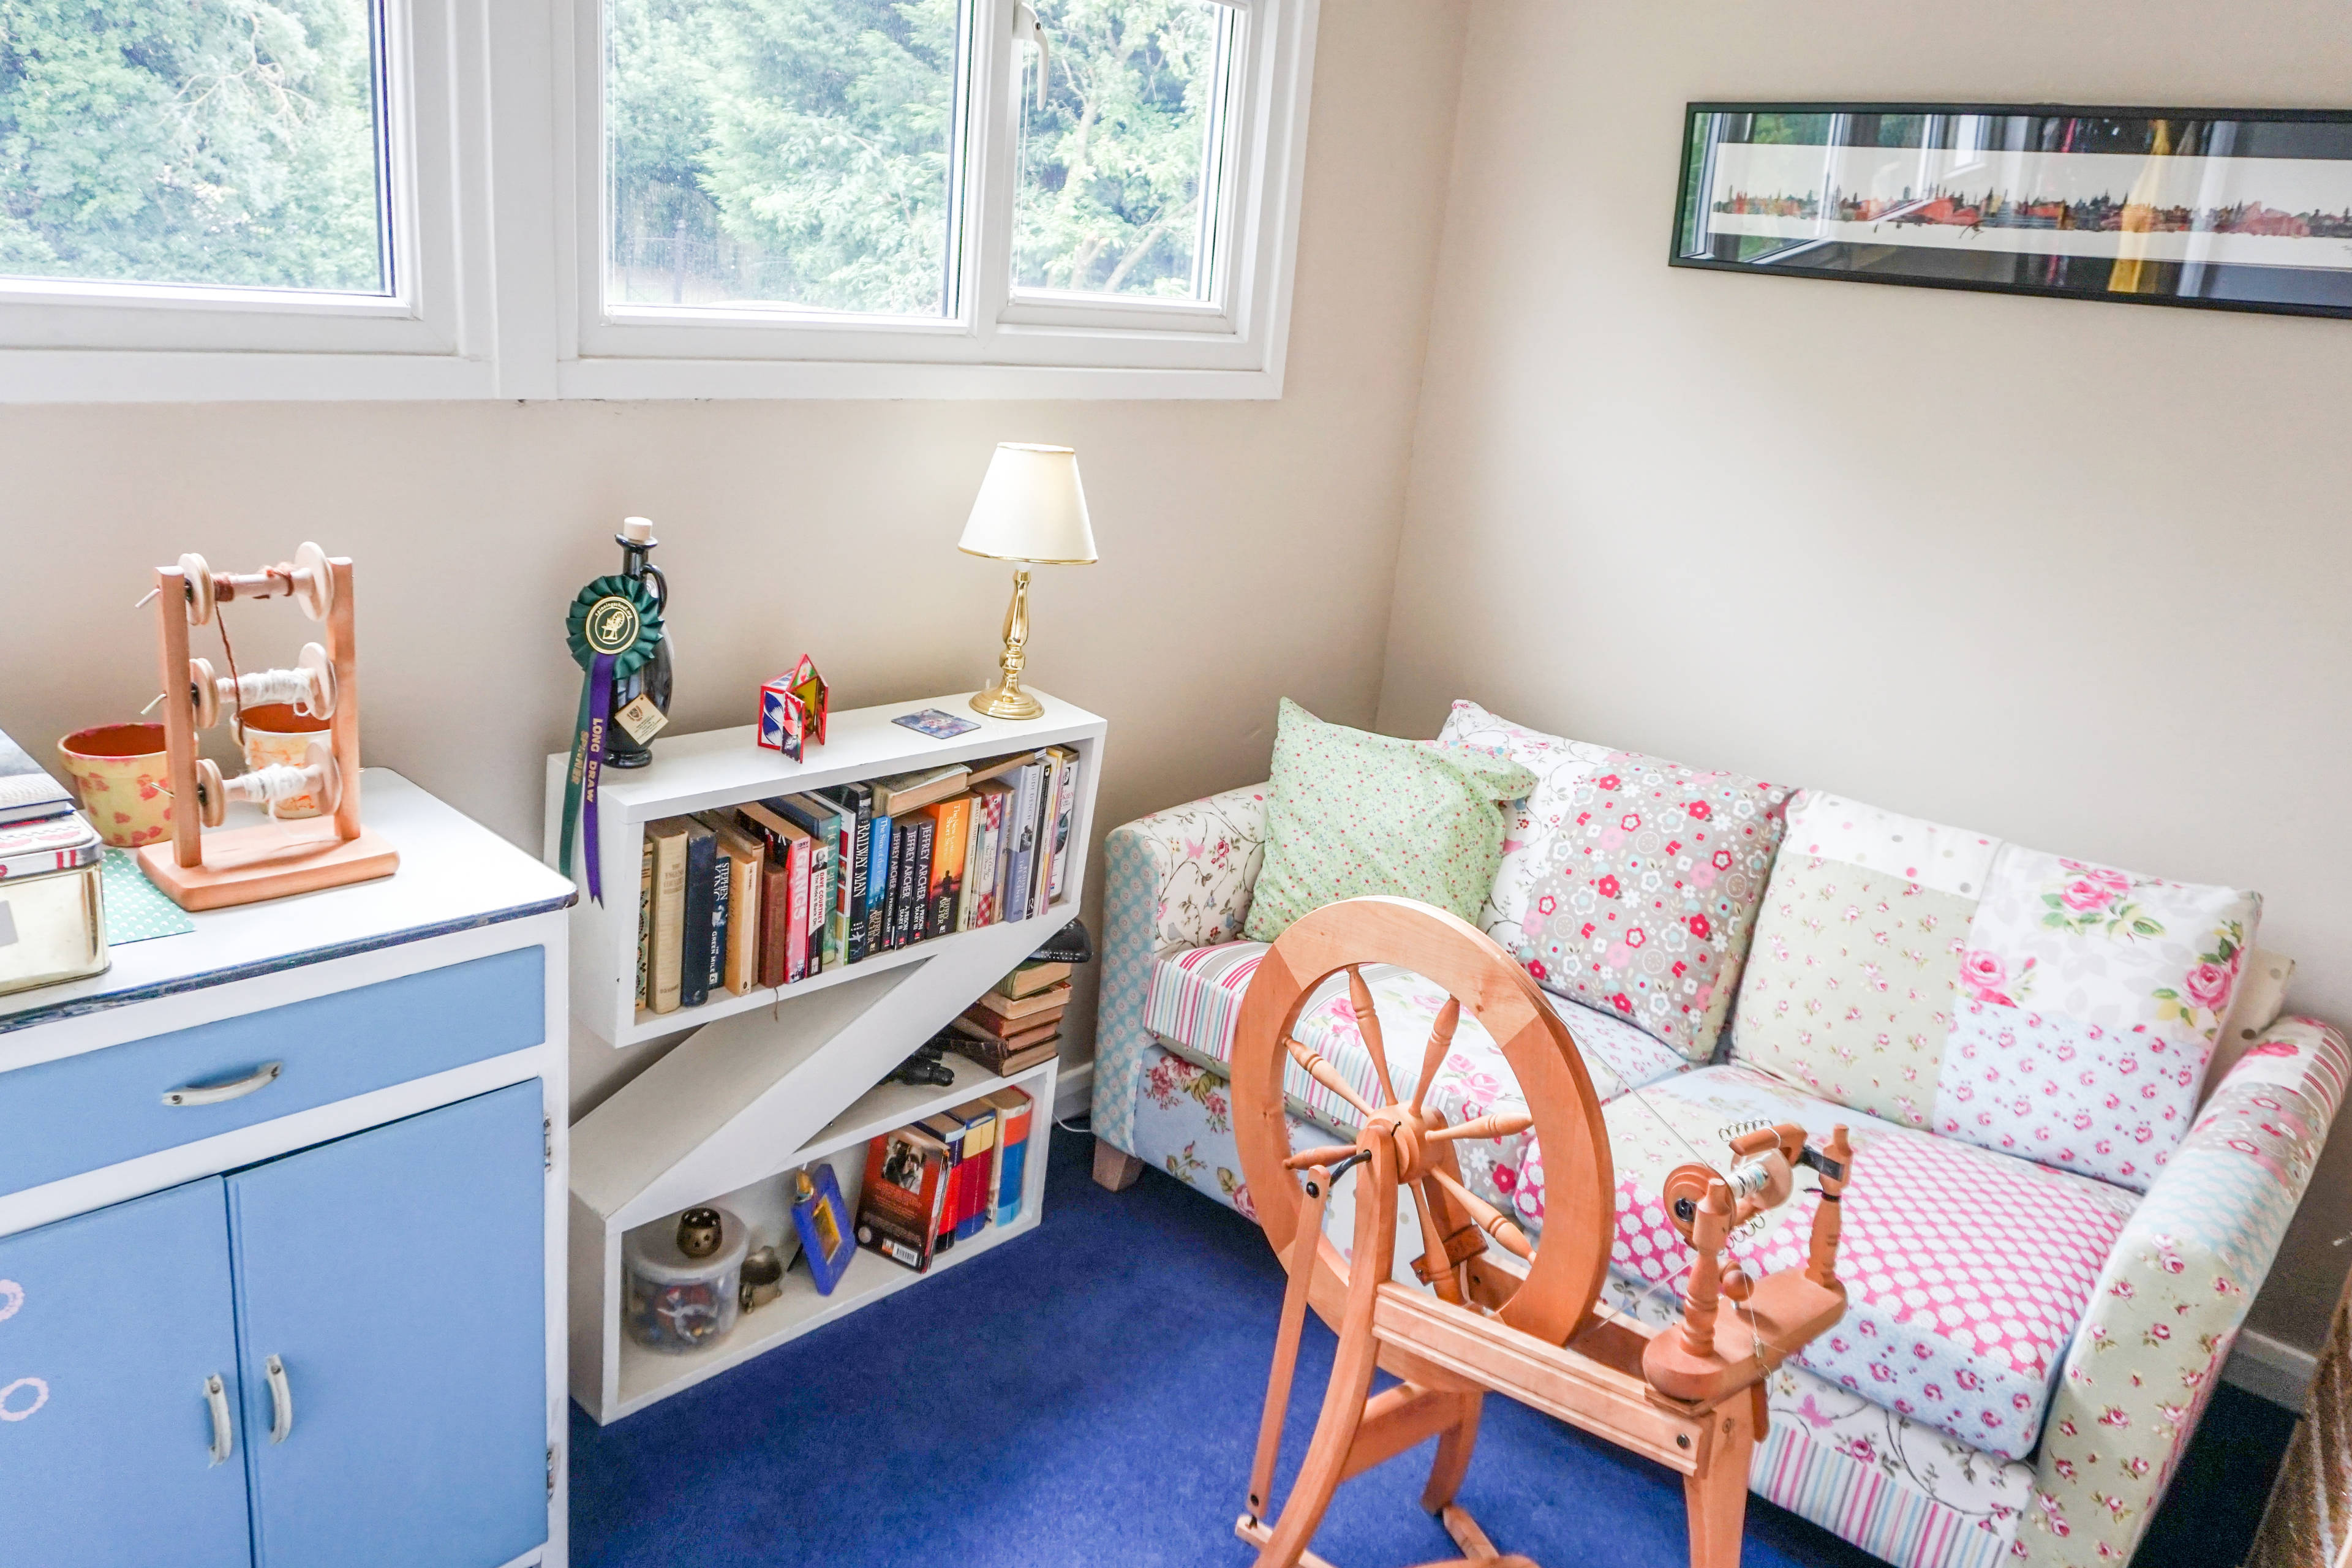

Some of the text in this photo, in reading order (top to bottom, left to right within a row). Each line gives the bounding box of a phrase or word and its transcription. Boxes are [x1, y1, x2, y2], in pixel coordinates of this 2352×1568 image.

[571, 730, 589, 785] SPINNER
[586, 718, 603, 802] LONG DRAW
[825, 825, 837, 907] HOLY BIBLE
[856, 823, 870, 869] RAILWAY
[892, 832, 901, 858] JEFFREY
[902, 831, 916, 899] JEFFREY ARCHER
[916, 827, 932, 902] JEFFREY ARCHER
[719, 862, 729, 900] STEPHEN
[794, 852, 807, 920] GANGS
[853, 871, 867, 898] MAN
[889, 861, 898, 889] ARCHER
[867, 910, 877, 943] ARCHER
[937, 896, 948, 925] ARCHER
